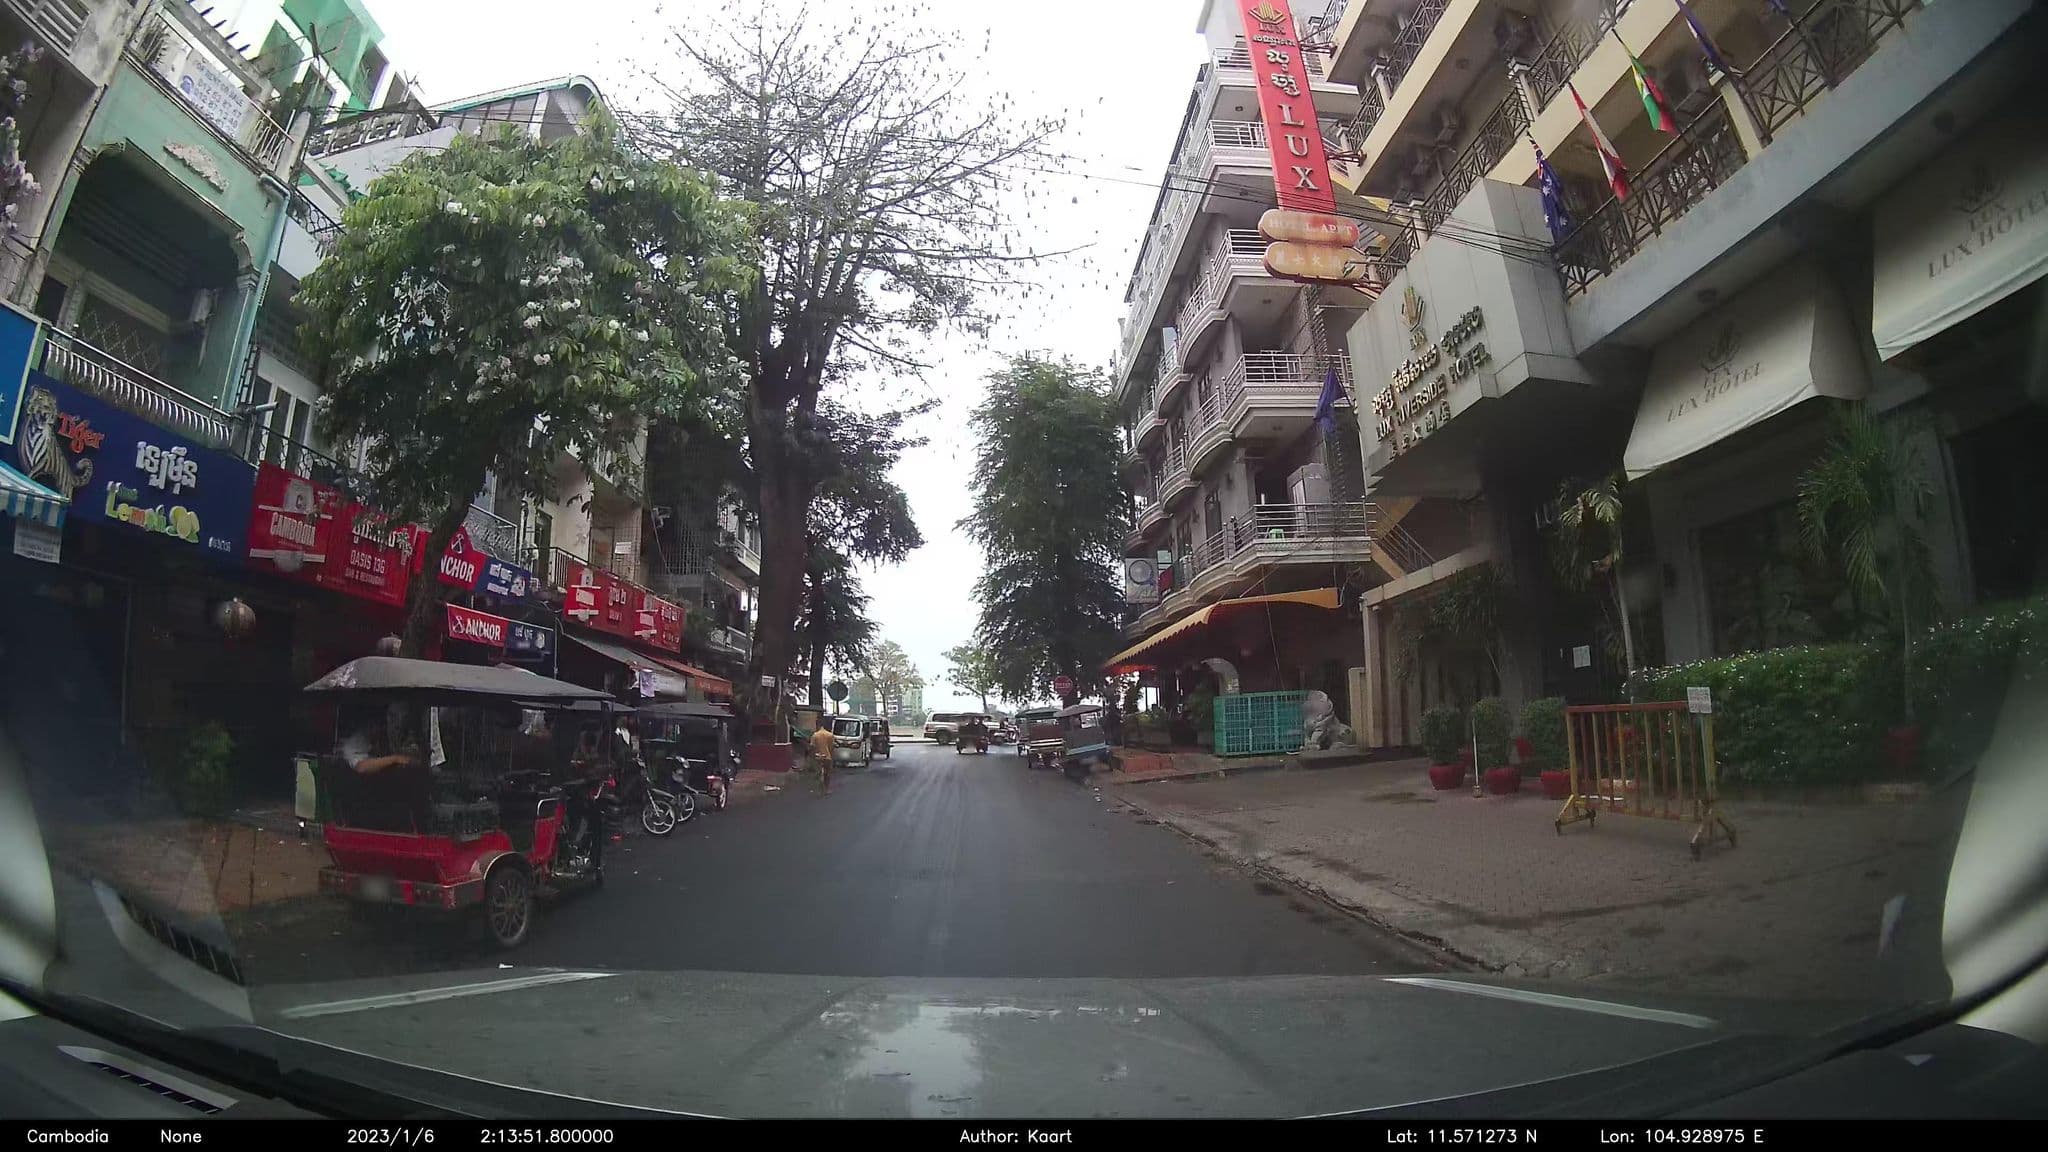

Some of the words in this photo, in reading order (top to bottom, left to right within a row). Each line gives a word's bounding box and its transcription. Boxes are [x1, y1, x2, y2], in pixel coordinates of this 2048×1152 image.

[1277, 103, 1319, 190] LUX
[1928, 240, 1973, 279] LUX
[1376, 415, 1394, 442] LUX
[1395, 373, 1448, 427] RIVERSIDE
[1448, 341, 1493, 384] HOTEL
[1704, 361, 1762, 404] HOTEL
[57, 412, 105, 454] Tiger
[270, 511, 316, 547] CAMBODIA
[349, 549, 372, 571] OASIS
[440, 557, 475, 583] NCHOR
[465, 617, 502, 642] ANCHOR
